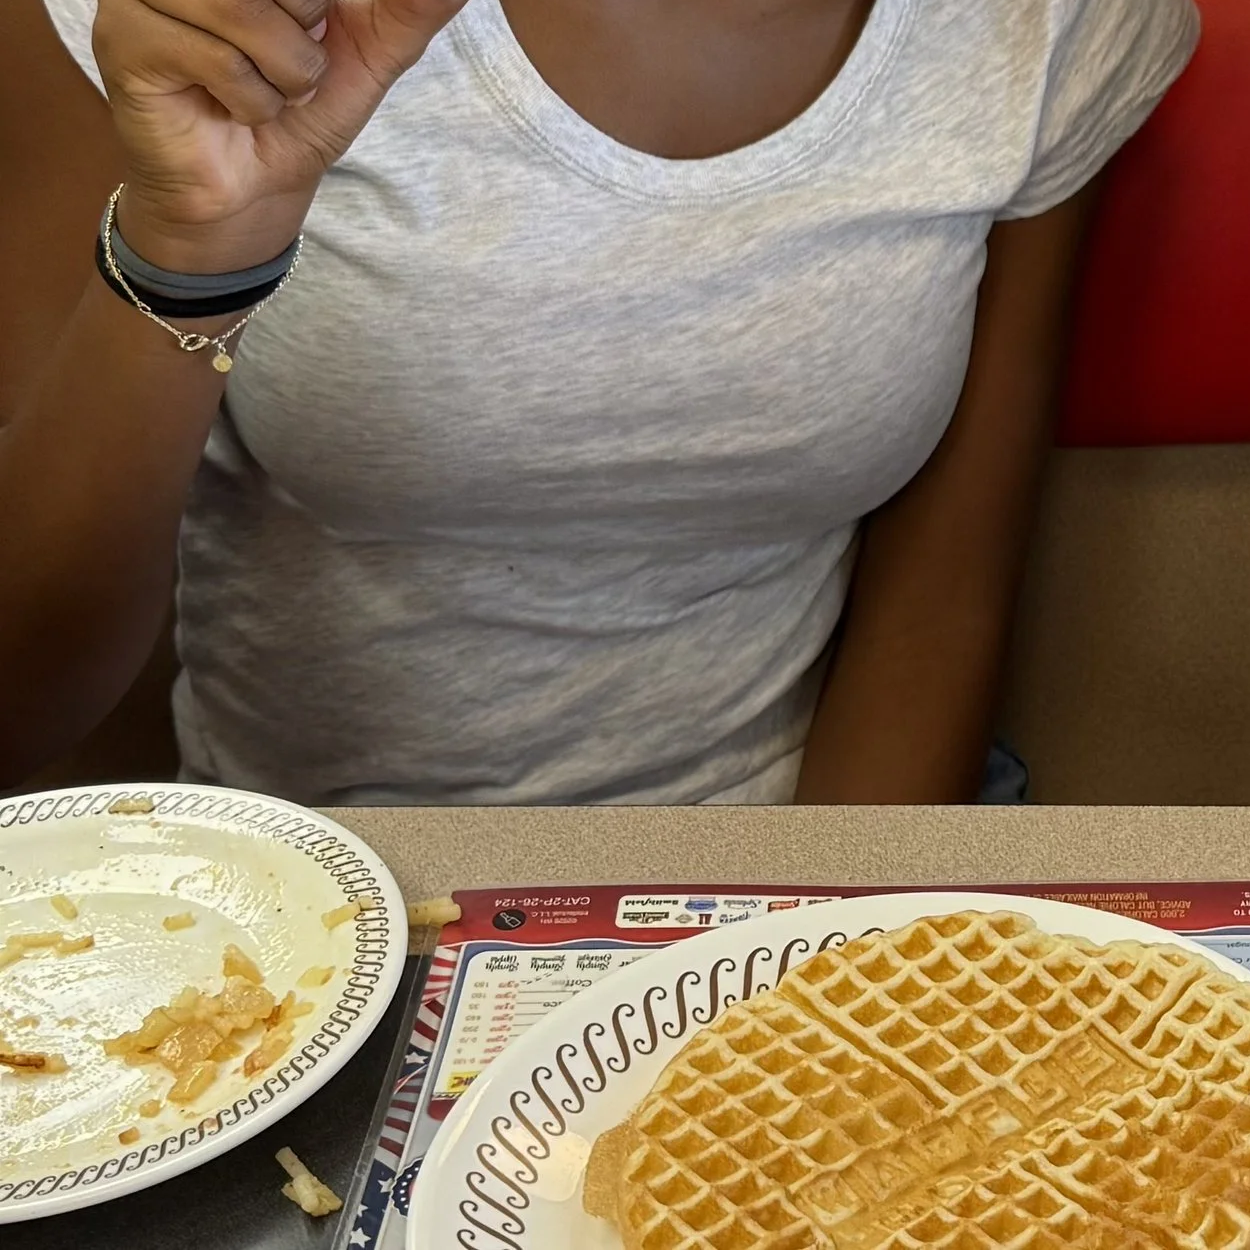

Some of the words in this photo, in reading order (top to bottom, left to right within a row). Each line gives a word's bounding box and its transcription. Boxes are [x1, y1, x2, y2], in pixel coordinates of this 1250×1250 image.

[1090, 892, 1148, 901] INFORMATION
[494, 896, 590, 907] CAT-2P-26-124
[1134, 900, 1155, 909] BUT
